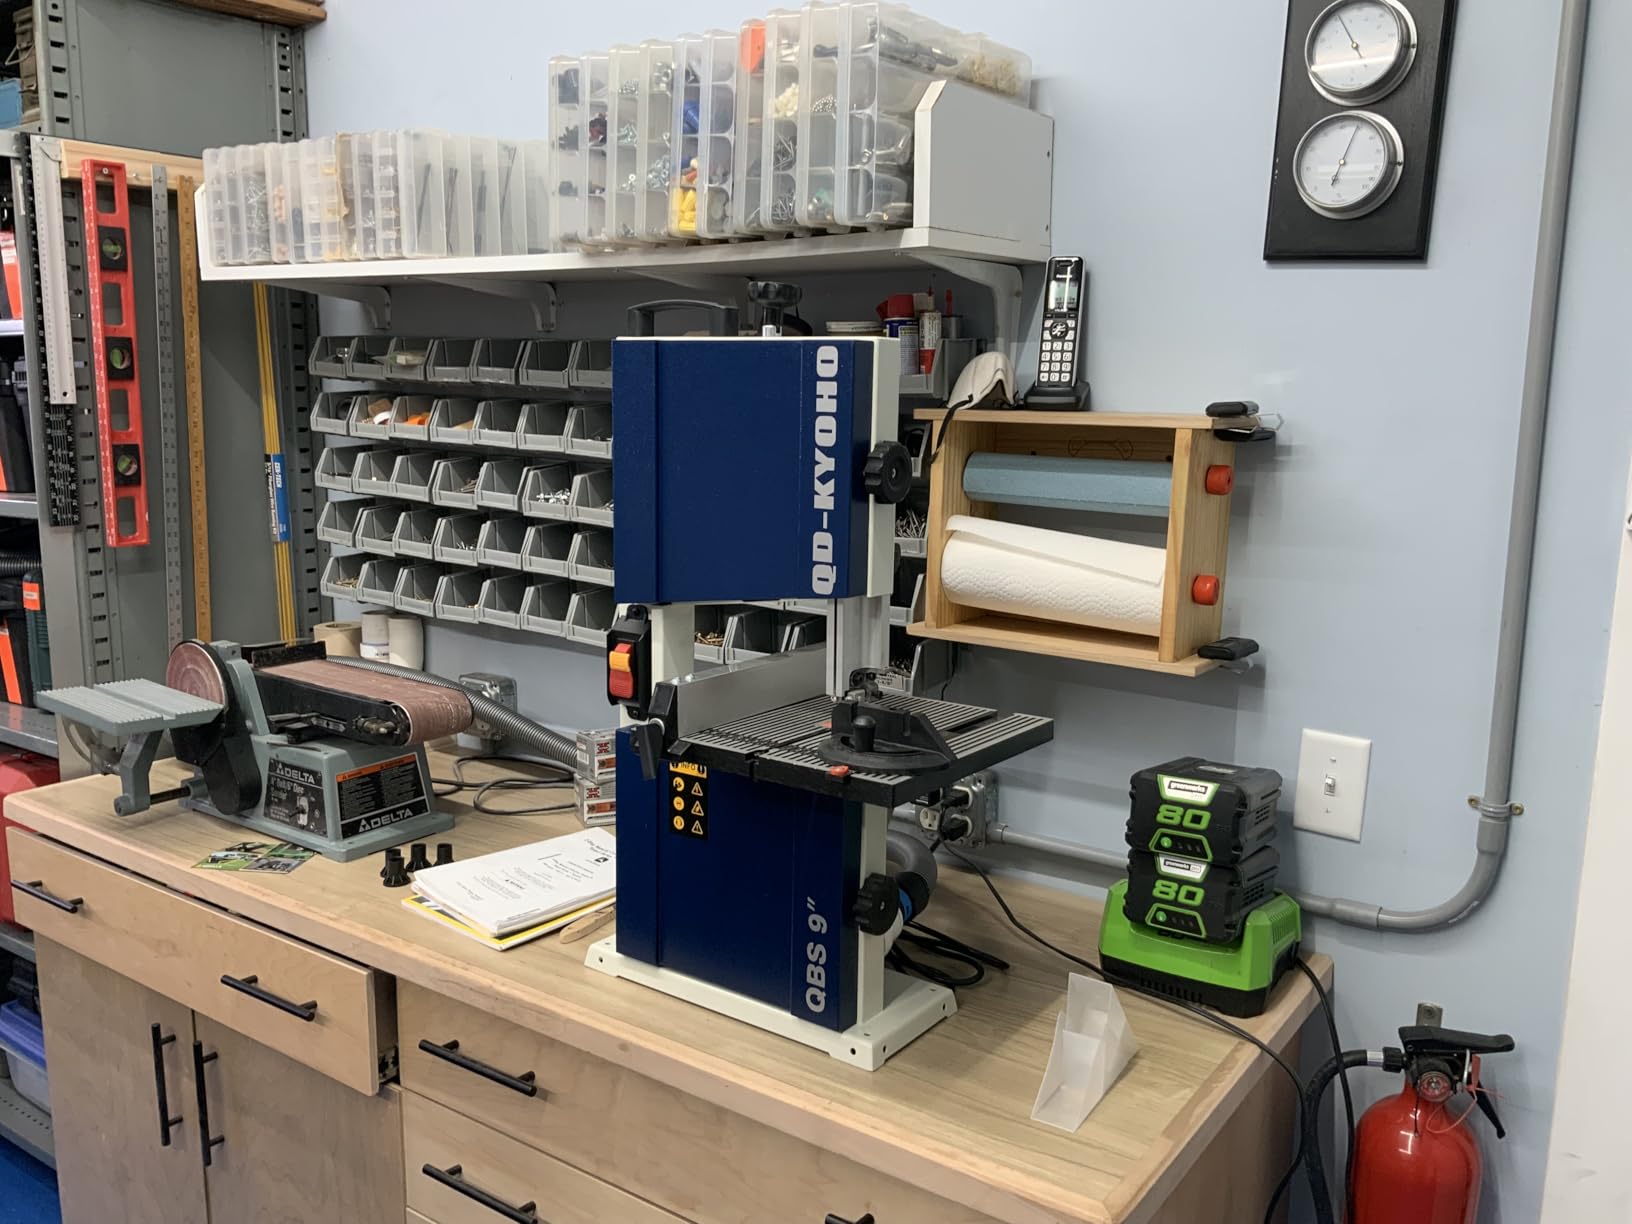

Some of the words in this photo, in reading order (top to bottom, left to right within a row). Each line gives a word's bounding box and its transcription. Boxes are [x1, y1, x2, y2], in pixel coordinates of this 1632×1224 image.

[811, 345, 839, 595] QD-KYOHO
[283, 768, 316, 785] DELTA
[1169, 780, 1207, 793] greenworks
[369, 808, 414, 829] DELTA
[1155, 803, 1212, 831] 80
[1151, 879, 1206, 907] 80
[806, 896, 828, 934] 9"
[805, 942, 827, 1013] QBS
